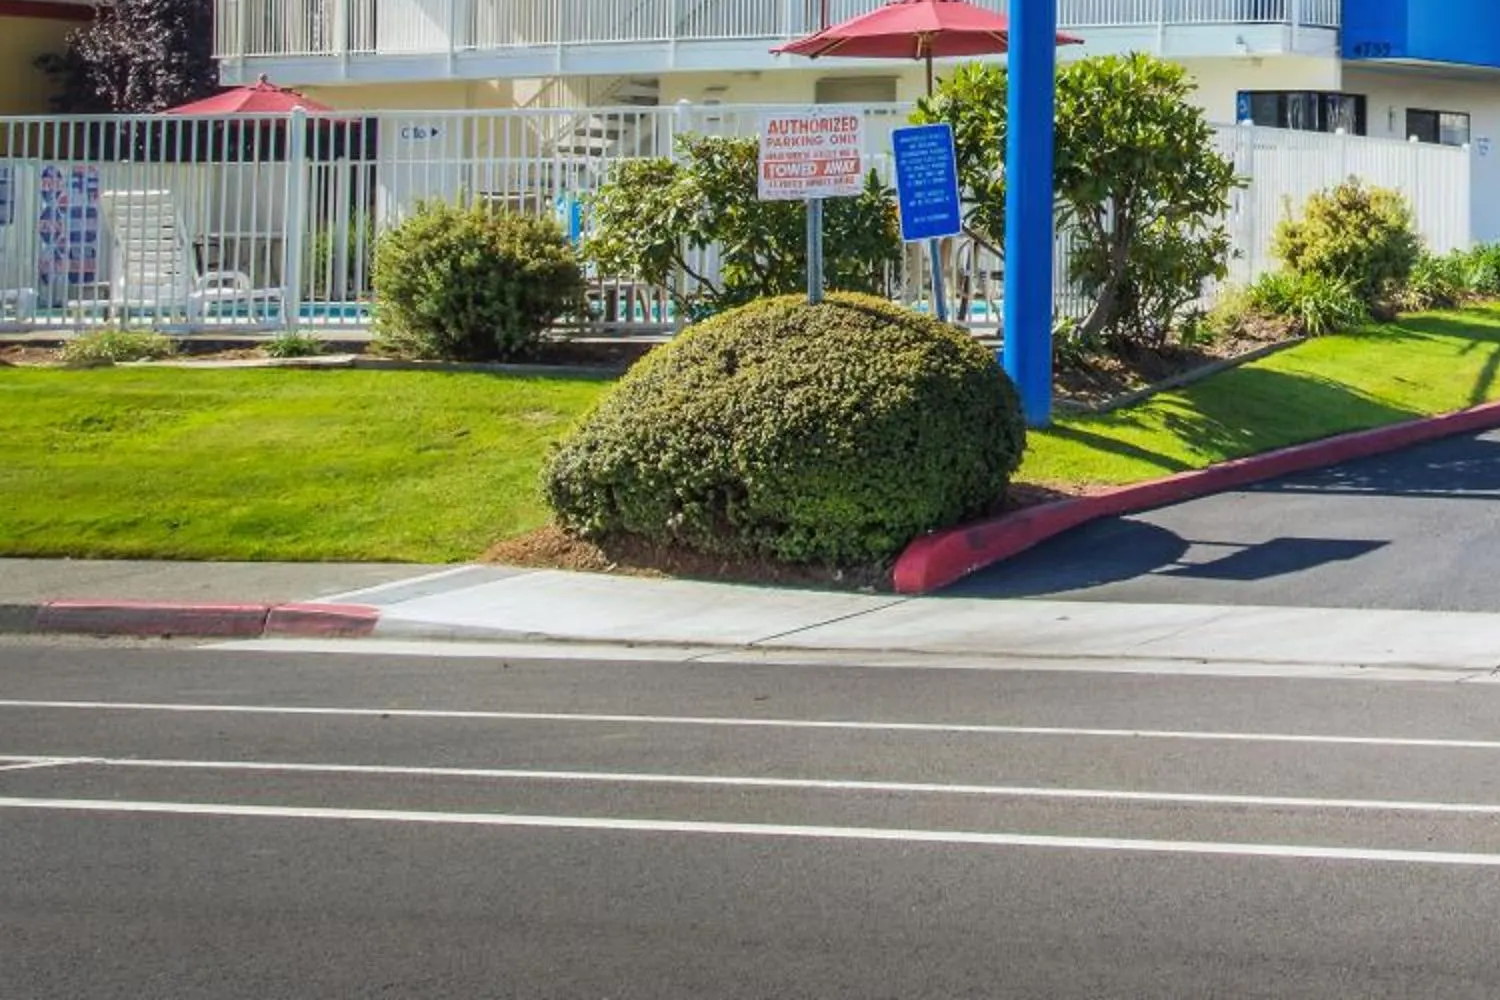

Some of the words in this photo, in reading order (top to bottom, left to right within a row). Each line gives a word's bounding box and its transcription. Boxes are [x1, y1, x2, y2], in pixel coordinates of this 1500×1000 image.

[768, 115, 858, 135] AUTHORIZED
[767, 135, 824, 147] PARKING
[830, 134, 858, 145] ONLY
[768, 161, 818, 178] TOWED
[824, 159, 857, 176] AWAY
